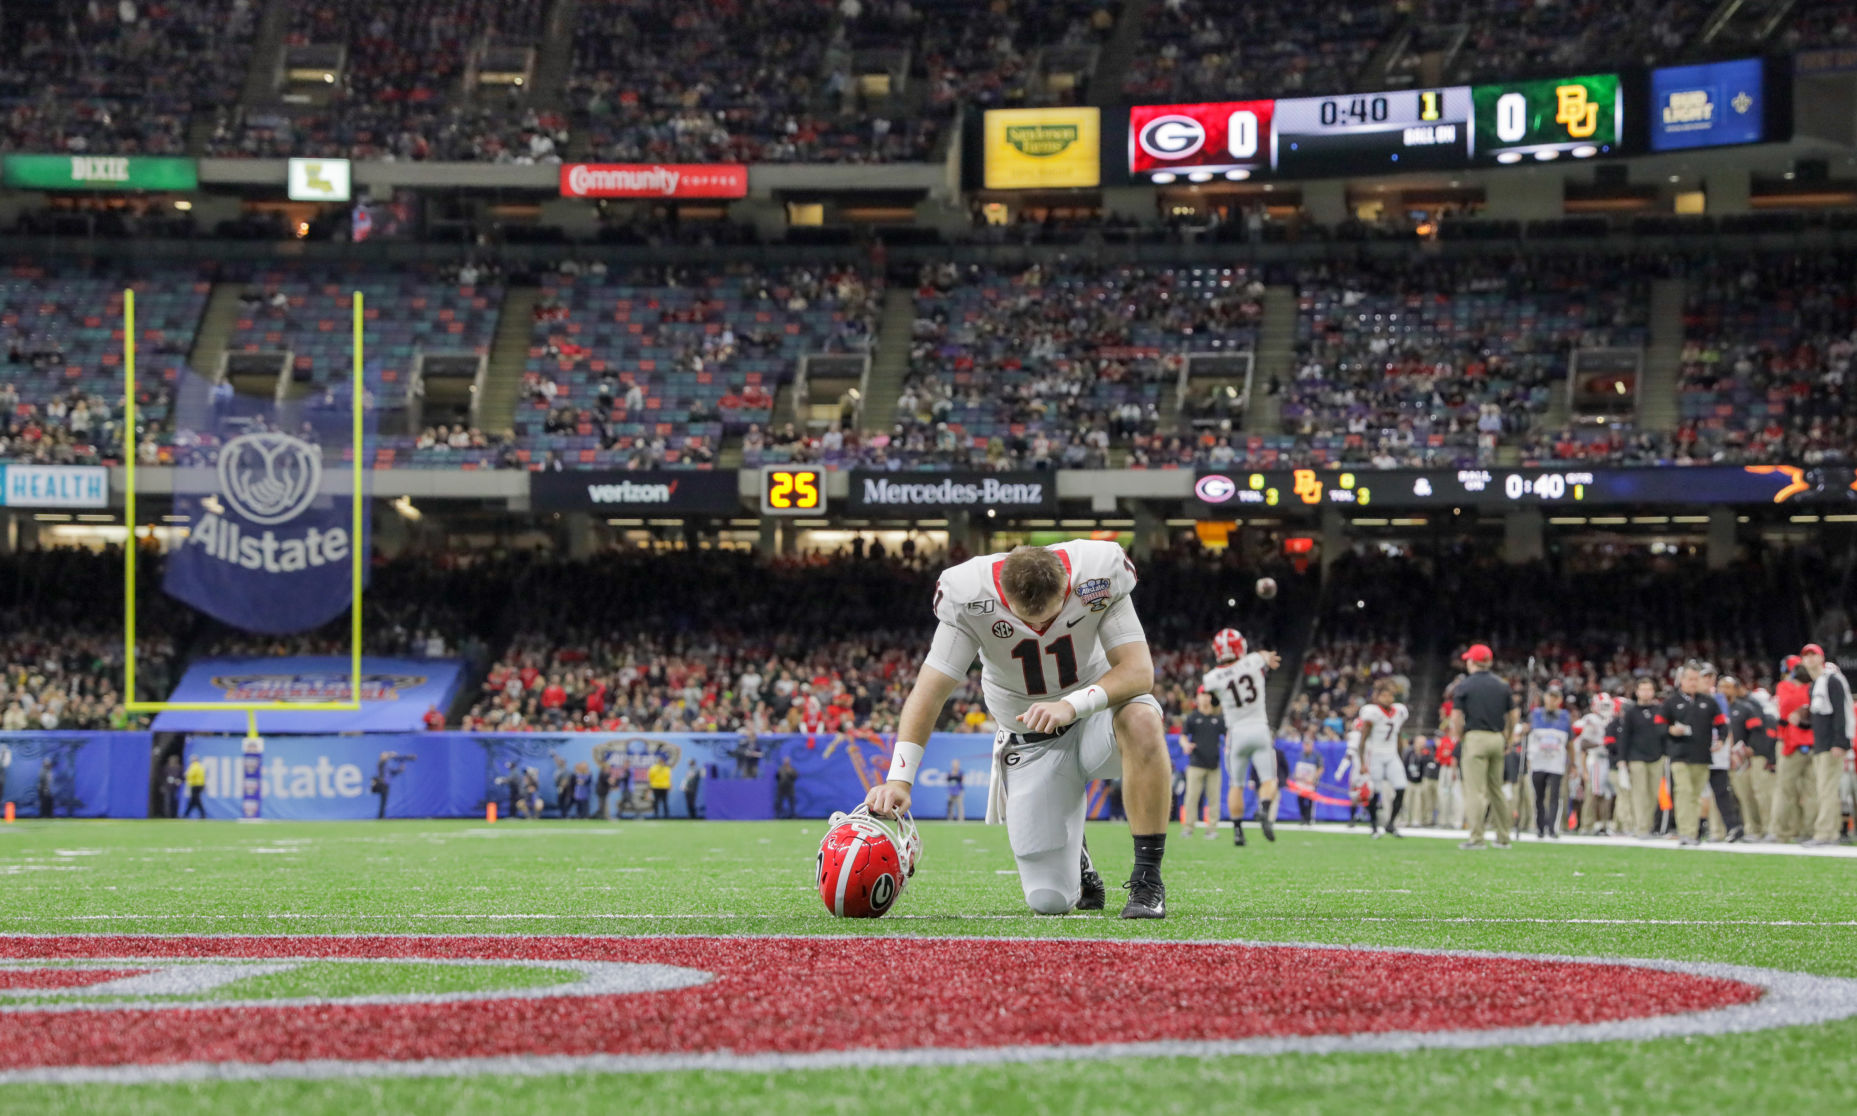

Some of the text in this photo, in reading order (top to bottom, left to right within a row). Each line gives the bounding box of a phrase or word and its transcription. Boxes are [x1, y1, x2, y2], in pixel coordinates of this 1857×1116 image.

[1320, 96, 1388, 126] 0:40
[1420, 91, 1440, 121] 1
[1496, 92, 1527, 142] 0
[1555, 84, 1599, 137] BU
[1228, 110, 1258, 158] 0
[71, 156, 130, 181] DIXIE
[569, 165, 680, 196] Community
[13, 474, 102, 498] HEALTH
[588, 480, 671, 503] verizon
[769, 471, 818, 508] 25
[863, 478, 1043, 504] Mercedes-Benz
[1265, 487, 1279, 506] 3
[1356, 487, 1371, 505] 3
[1505, 473, 1565, 499] 0:40
[188, 512, 349, 573] Allstate
[993, 621, 1014, 638] SEC
[1011, 634, 1079, 696] 11
[1226, 674, 1257, 708] 13
[1383, 723, 1395, 741] 7
[1005, 752, 1021, 766] G
